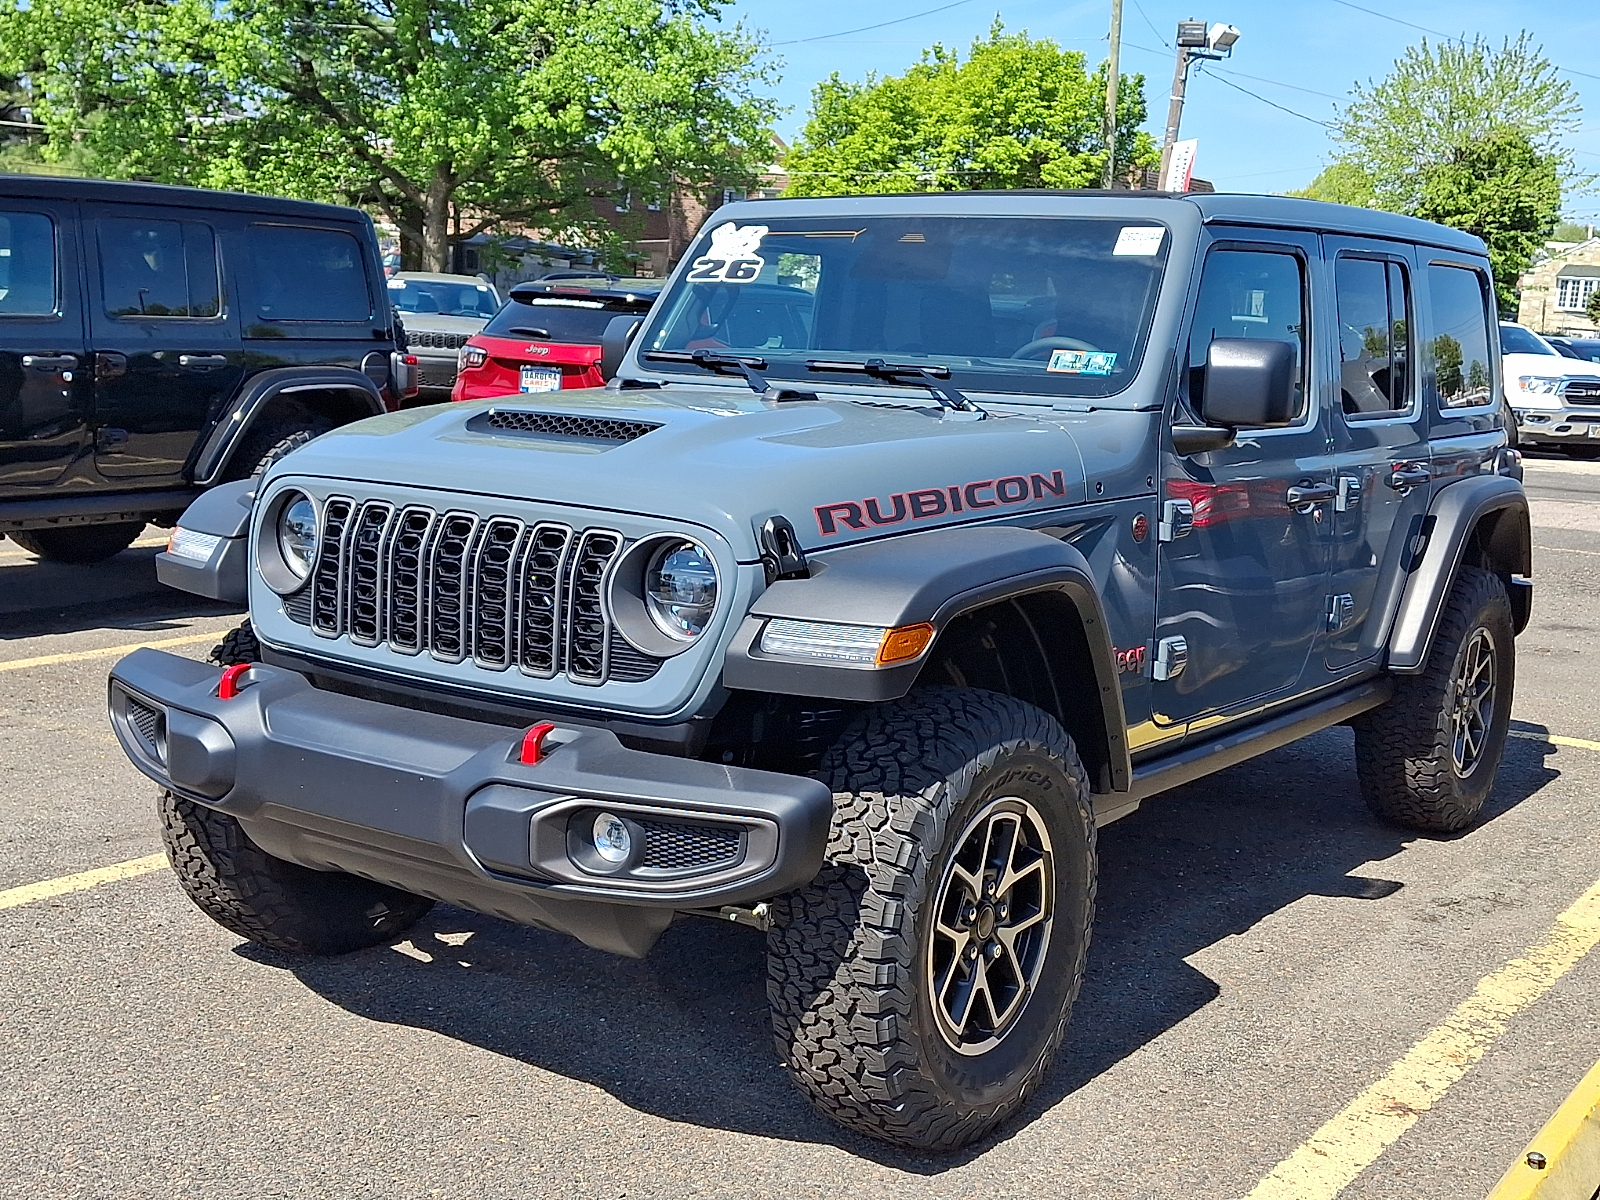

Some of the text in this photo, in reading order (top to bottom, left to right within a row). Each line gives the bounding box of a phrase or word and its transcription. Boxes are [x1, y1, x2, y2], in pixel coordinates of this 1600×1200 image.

[690, 259, 761, 280] 26
[525, 344, 549, 356] Jeep
[813, 469, 1067, 536] RUBICON
[1112, 646, 1146, 674] eep
